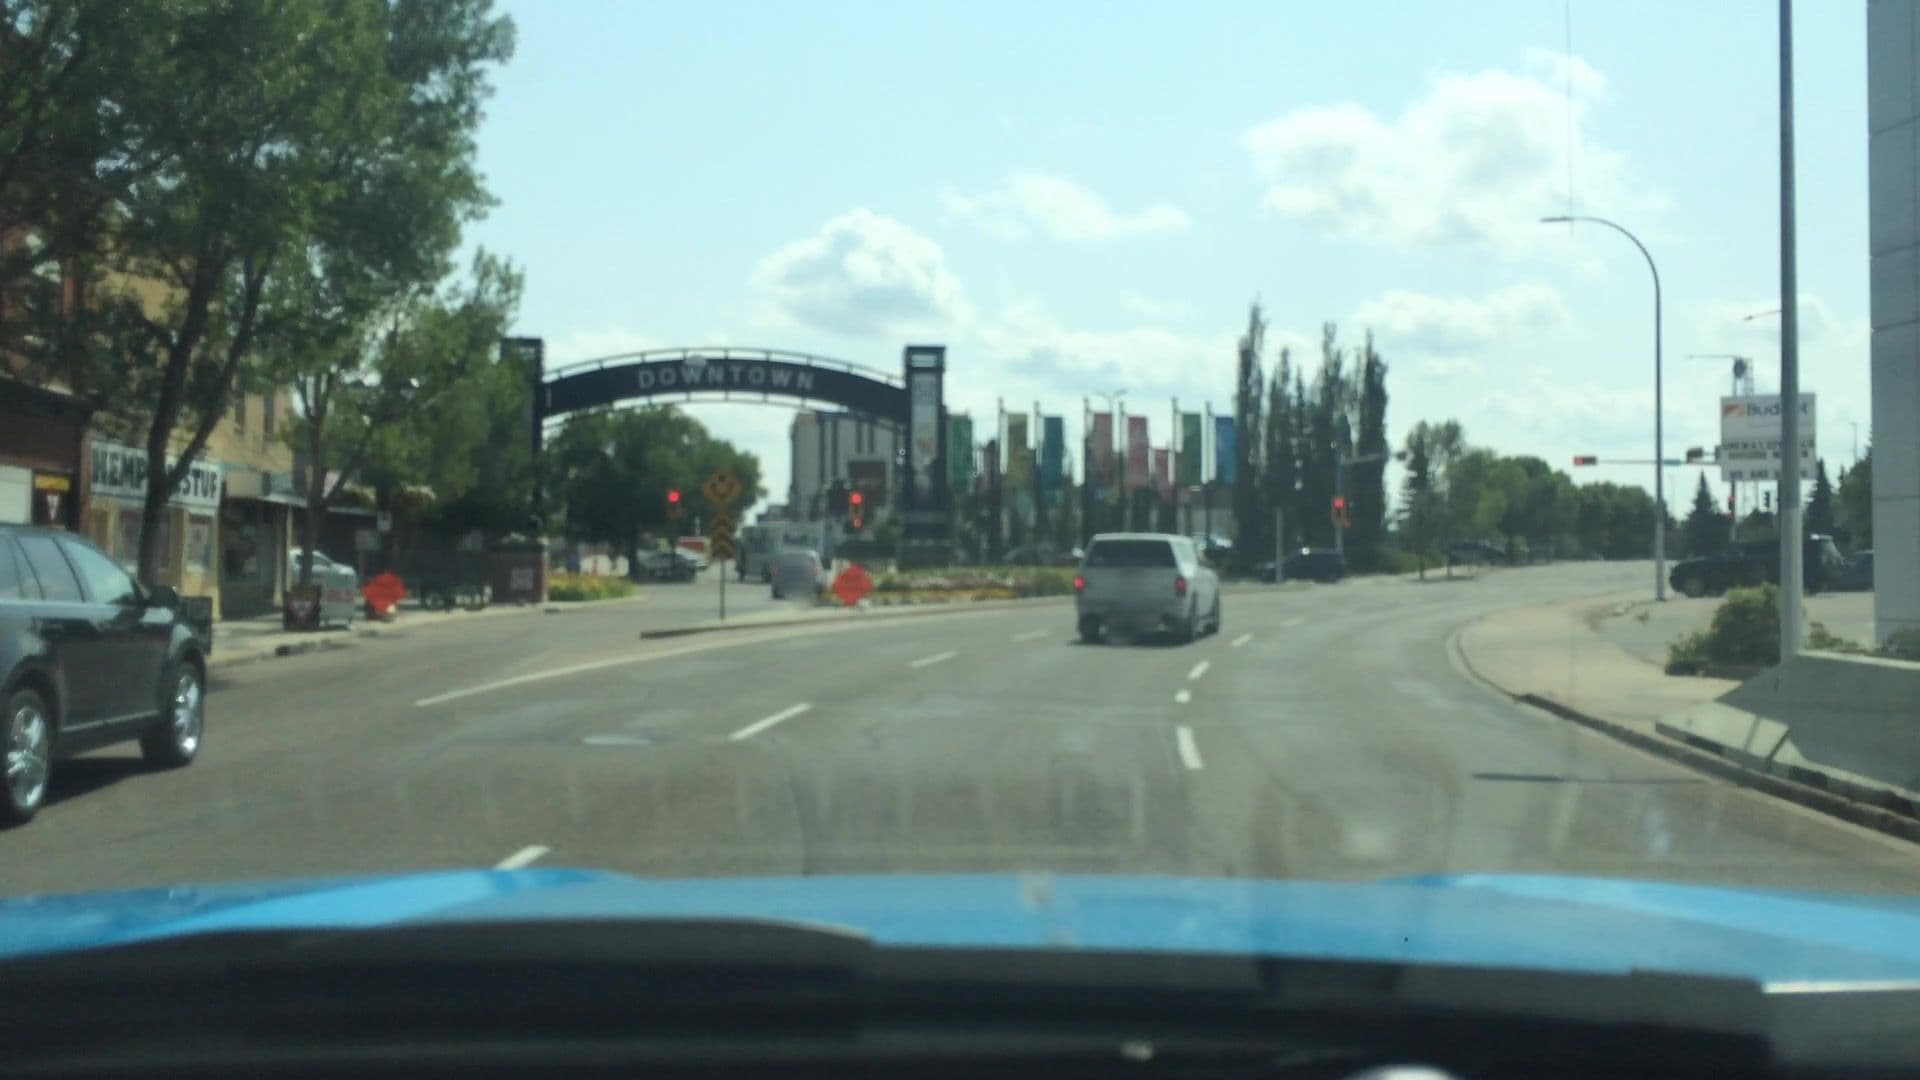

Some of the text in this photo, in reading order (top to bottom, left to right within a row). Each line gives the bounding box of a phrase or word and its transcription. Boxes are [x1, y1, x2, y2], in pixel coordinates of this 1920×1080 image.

[639, 365, 815, 389] DOWNTOWN
[1747, 402, 1808, 416] Budt
[92, 447, 148, 489] HEMP
